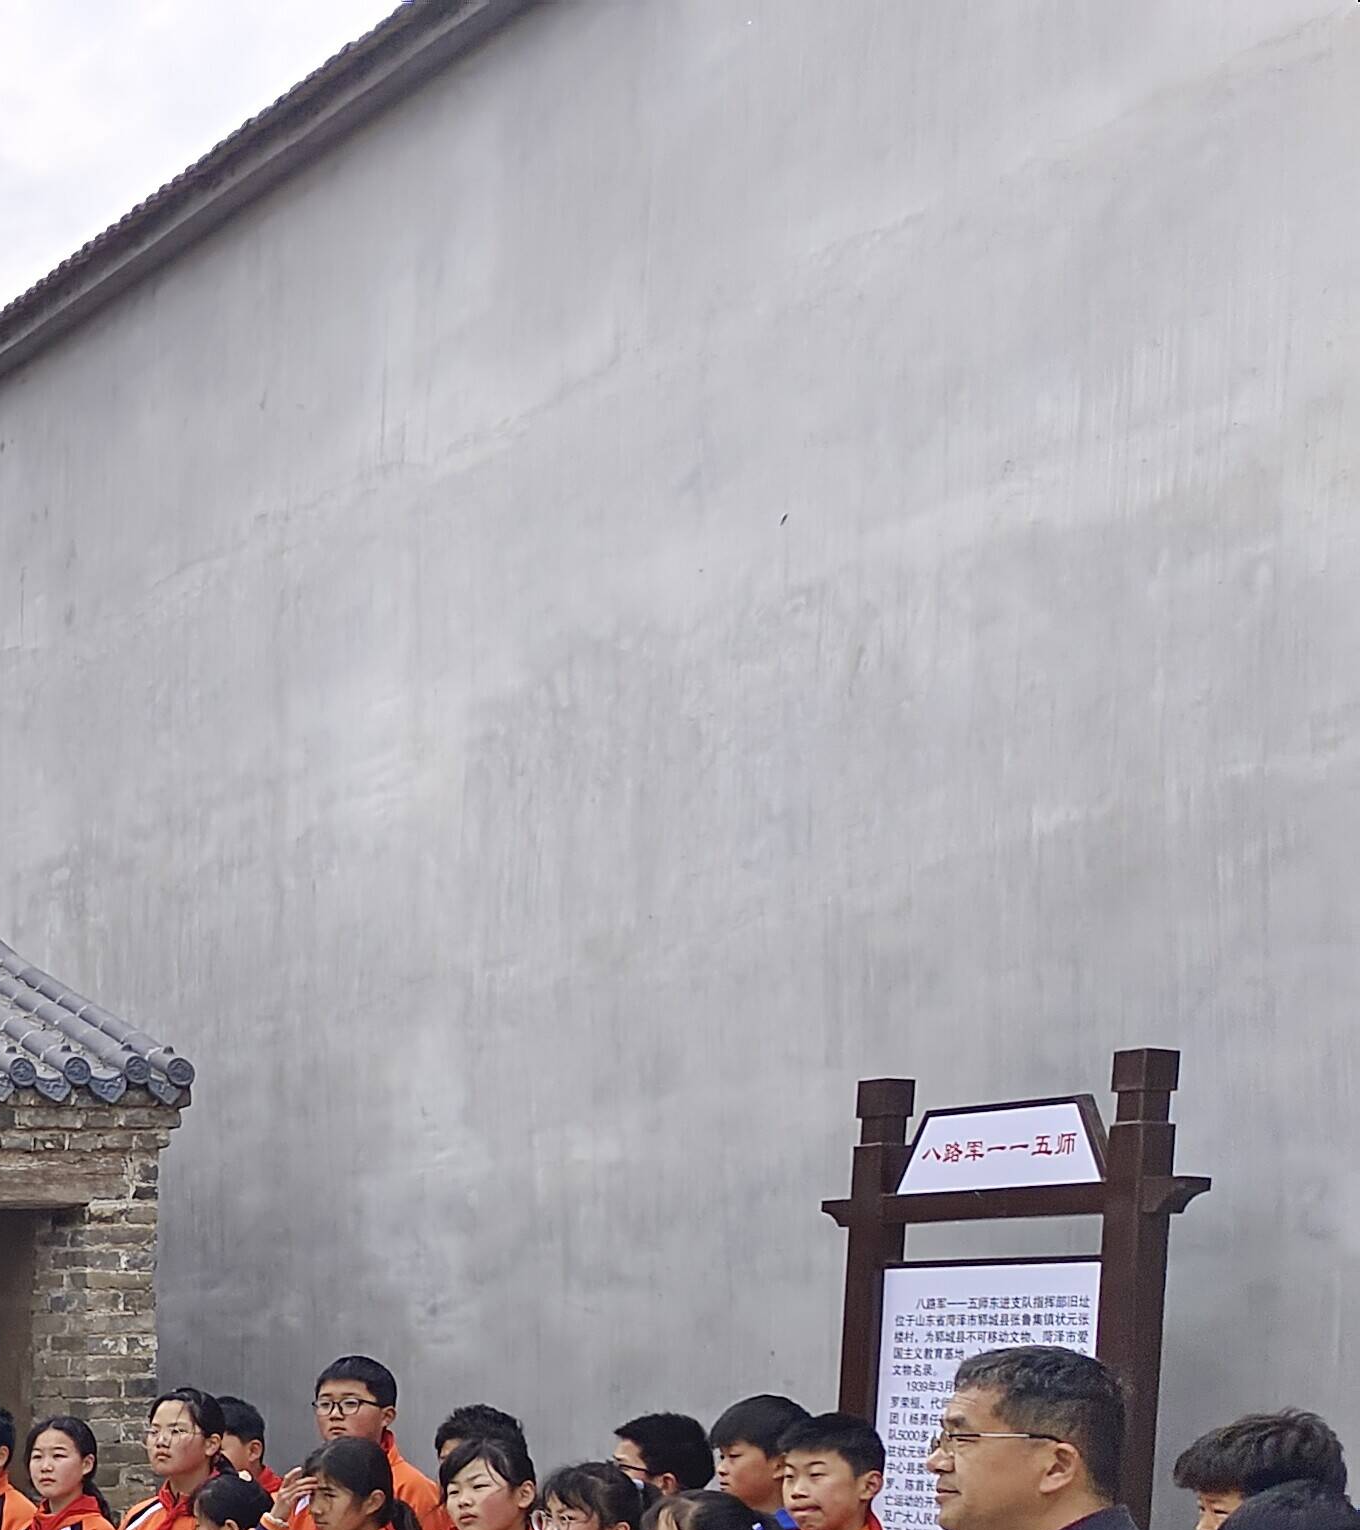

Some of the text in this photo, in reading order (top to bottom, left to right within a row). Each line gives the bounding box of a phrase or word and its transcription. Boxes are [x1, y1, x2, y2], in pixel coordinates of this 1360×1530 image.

[921, 1132, 1077, 1162] 八路军一一五师
